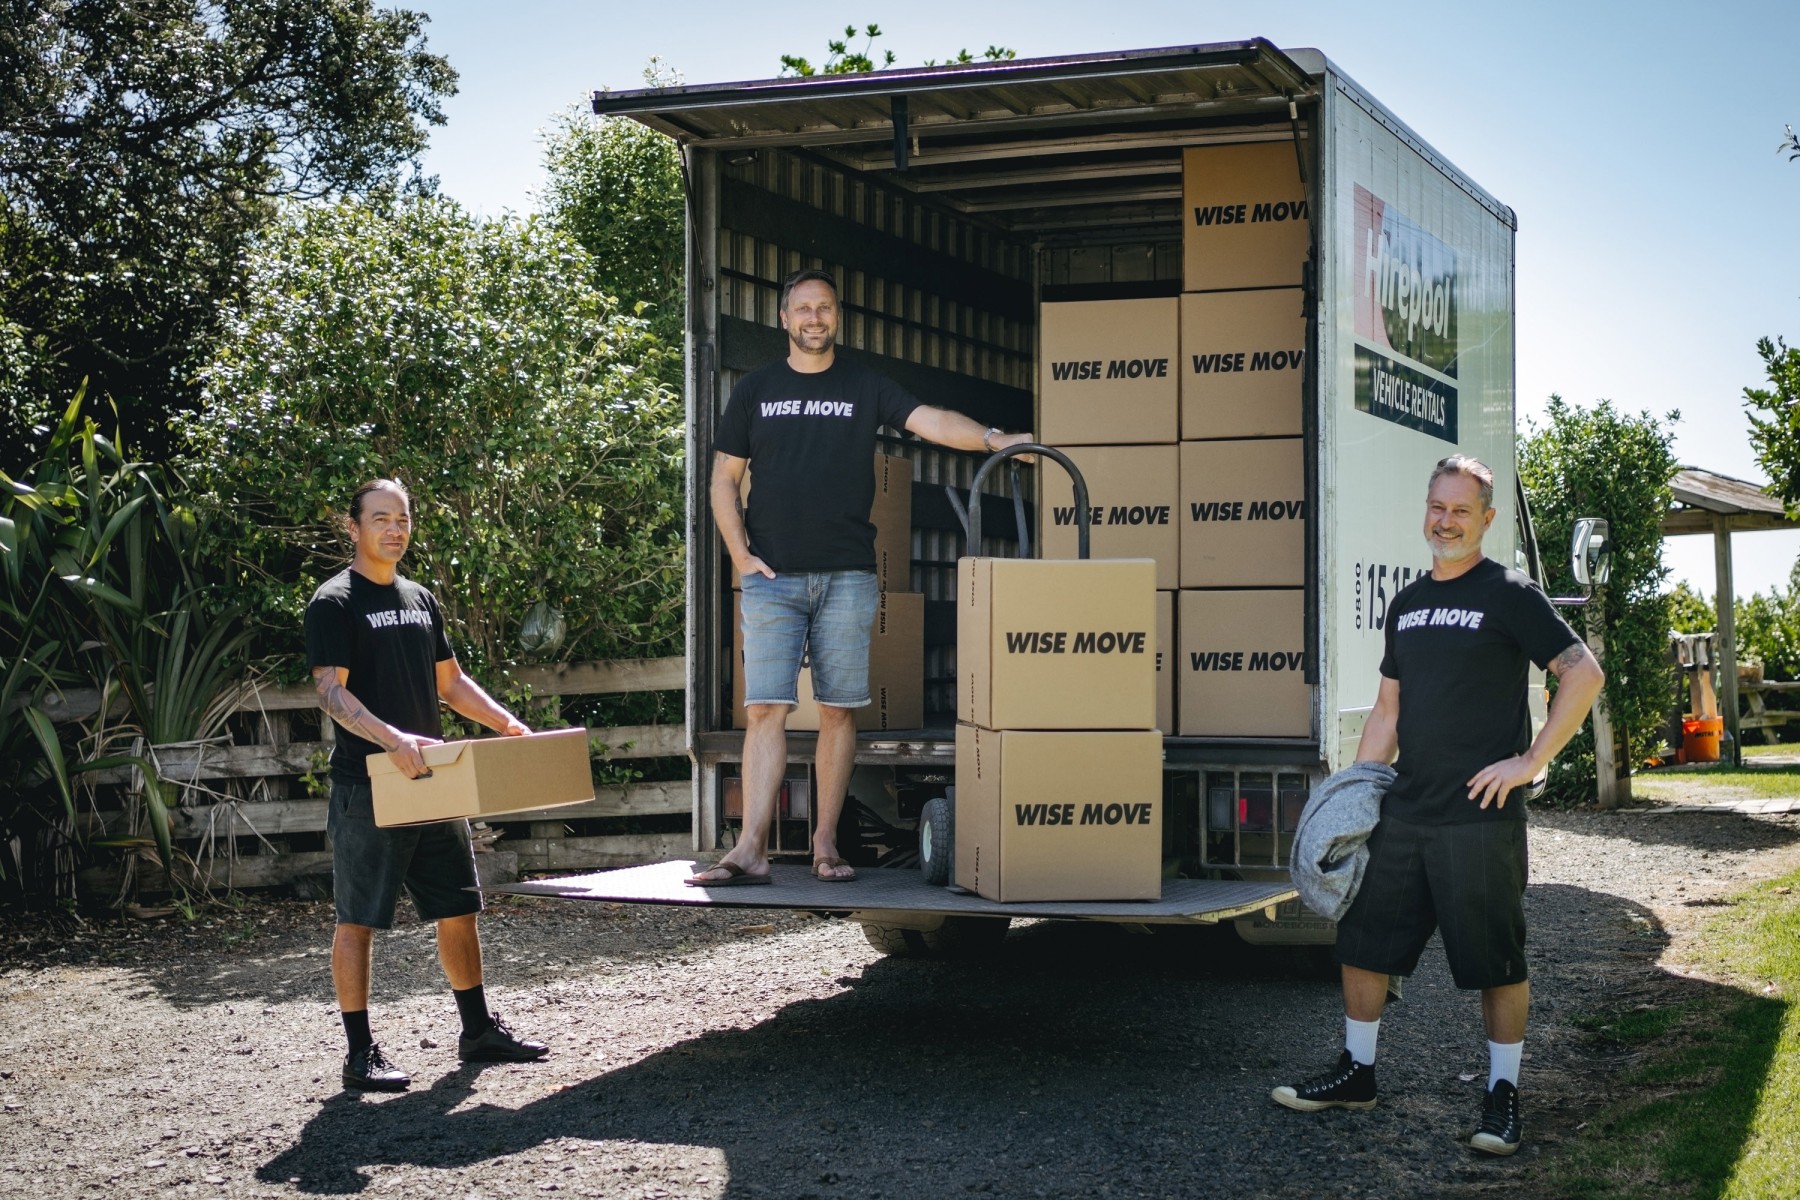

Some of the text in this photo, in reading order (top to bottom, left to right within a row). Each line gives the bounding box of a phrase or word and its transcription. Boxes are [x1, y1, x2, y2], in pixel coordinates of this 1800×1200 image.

[1194, 204, 1247, 226] WISE
[1364, 228, 1450, 341] Hirepool
[1051, 358, 1168, 381] WISE MOVE
[1192, 350, 1303, 374] WISE MOV
[1373, 367, 1445, 427] VEHICLE RENTALS
[761, 400, 854, 417] WISE MOVE
[1107, 506, 1170, 525] MOVE
[1190, 502, 1243, 522] WISE
[1367, 563, 1387, 631] 15
[366, 609, 399, 629] WISE
[1397, 608, 1484, 631] WISE MOVE
[1006, 632, 1146, 654] WISE MOVE
[1190, 652, 1244, 671] WISE
[1015, 803, 1152, 826] WISE MOVE
